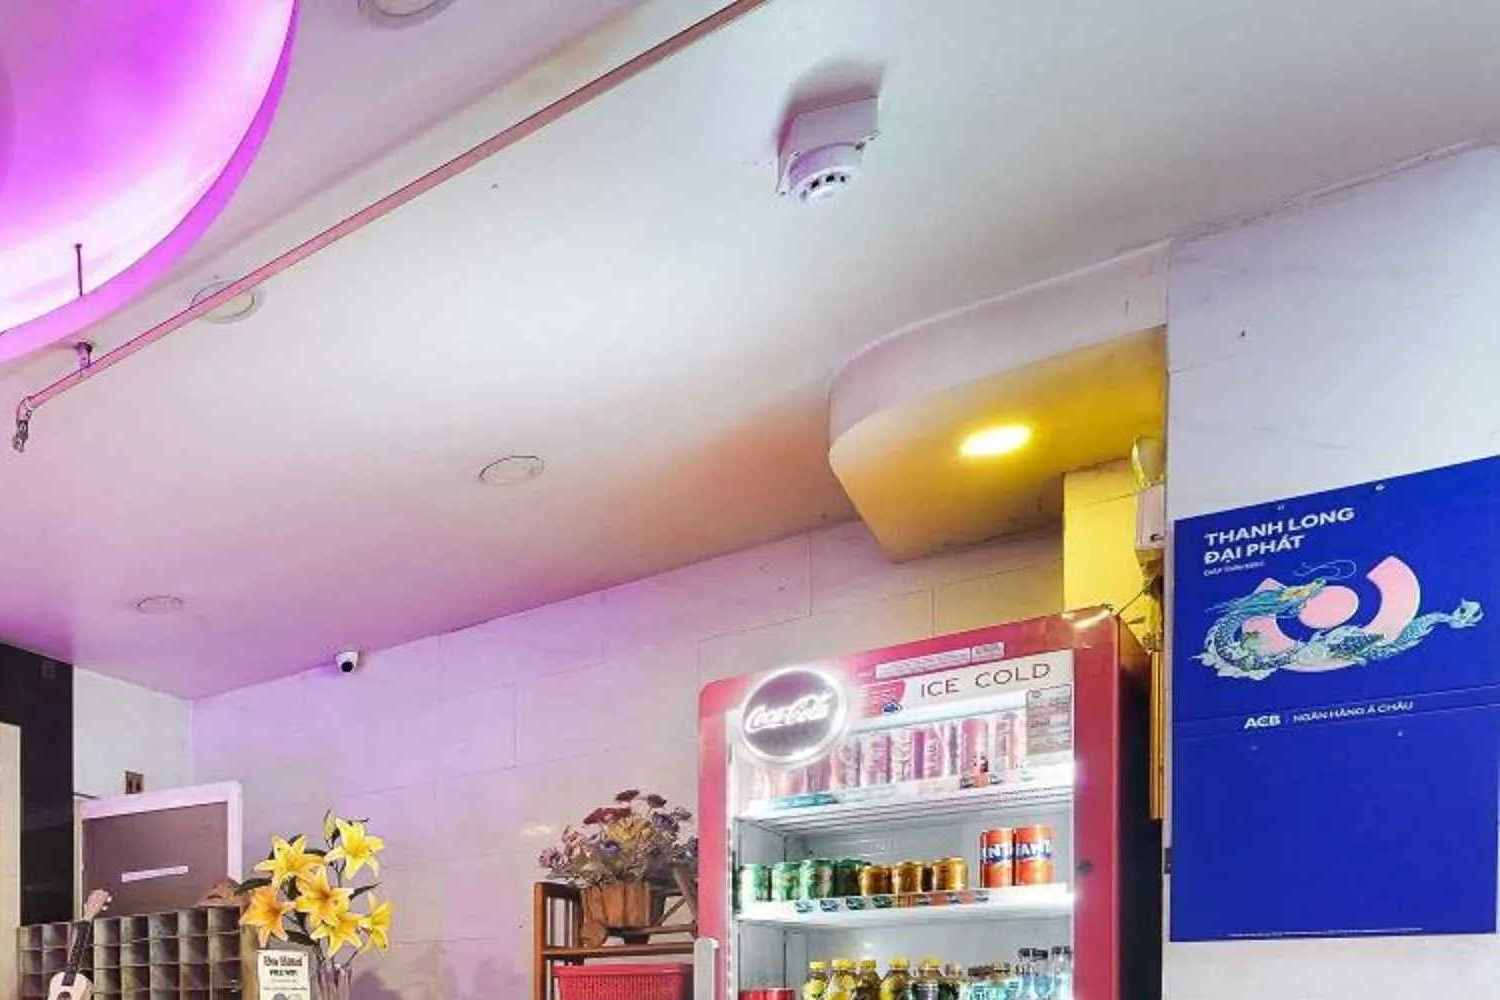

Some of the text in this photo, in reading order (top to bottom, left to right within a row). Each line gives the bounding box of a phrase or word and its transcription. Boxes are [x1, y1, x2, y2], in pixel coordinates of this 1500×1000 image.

[1203, 507, 1355, 547] THANH LONG
[1203, 533, 1305, 565] ĐẠI PHÁT
[920, 677, 960, 698] ICE
[974, 662, 1051, 689] COLD
[745, 690, 834, 733] Coca-Cola
[1243, 714, 1281, 729] ACB
